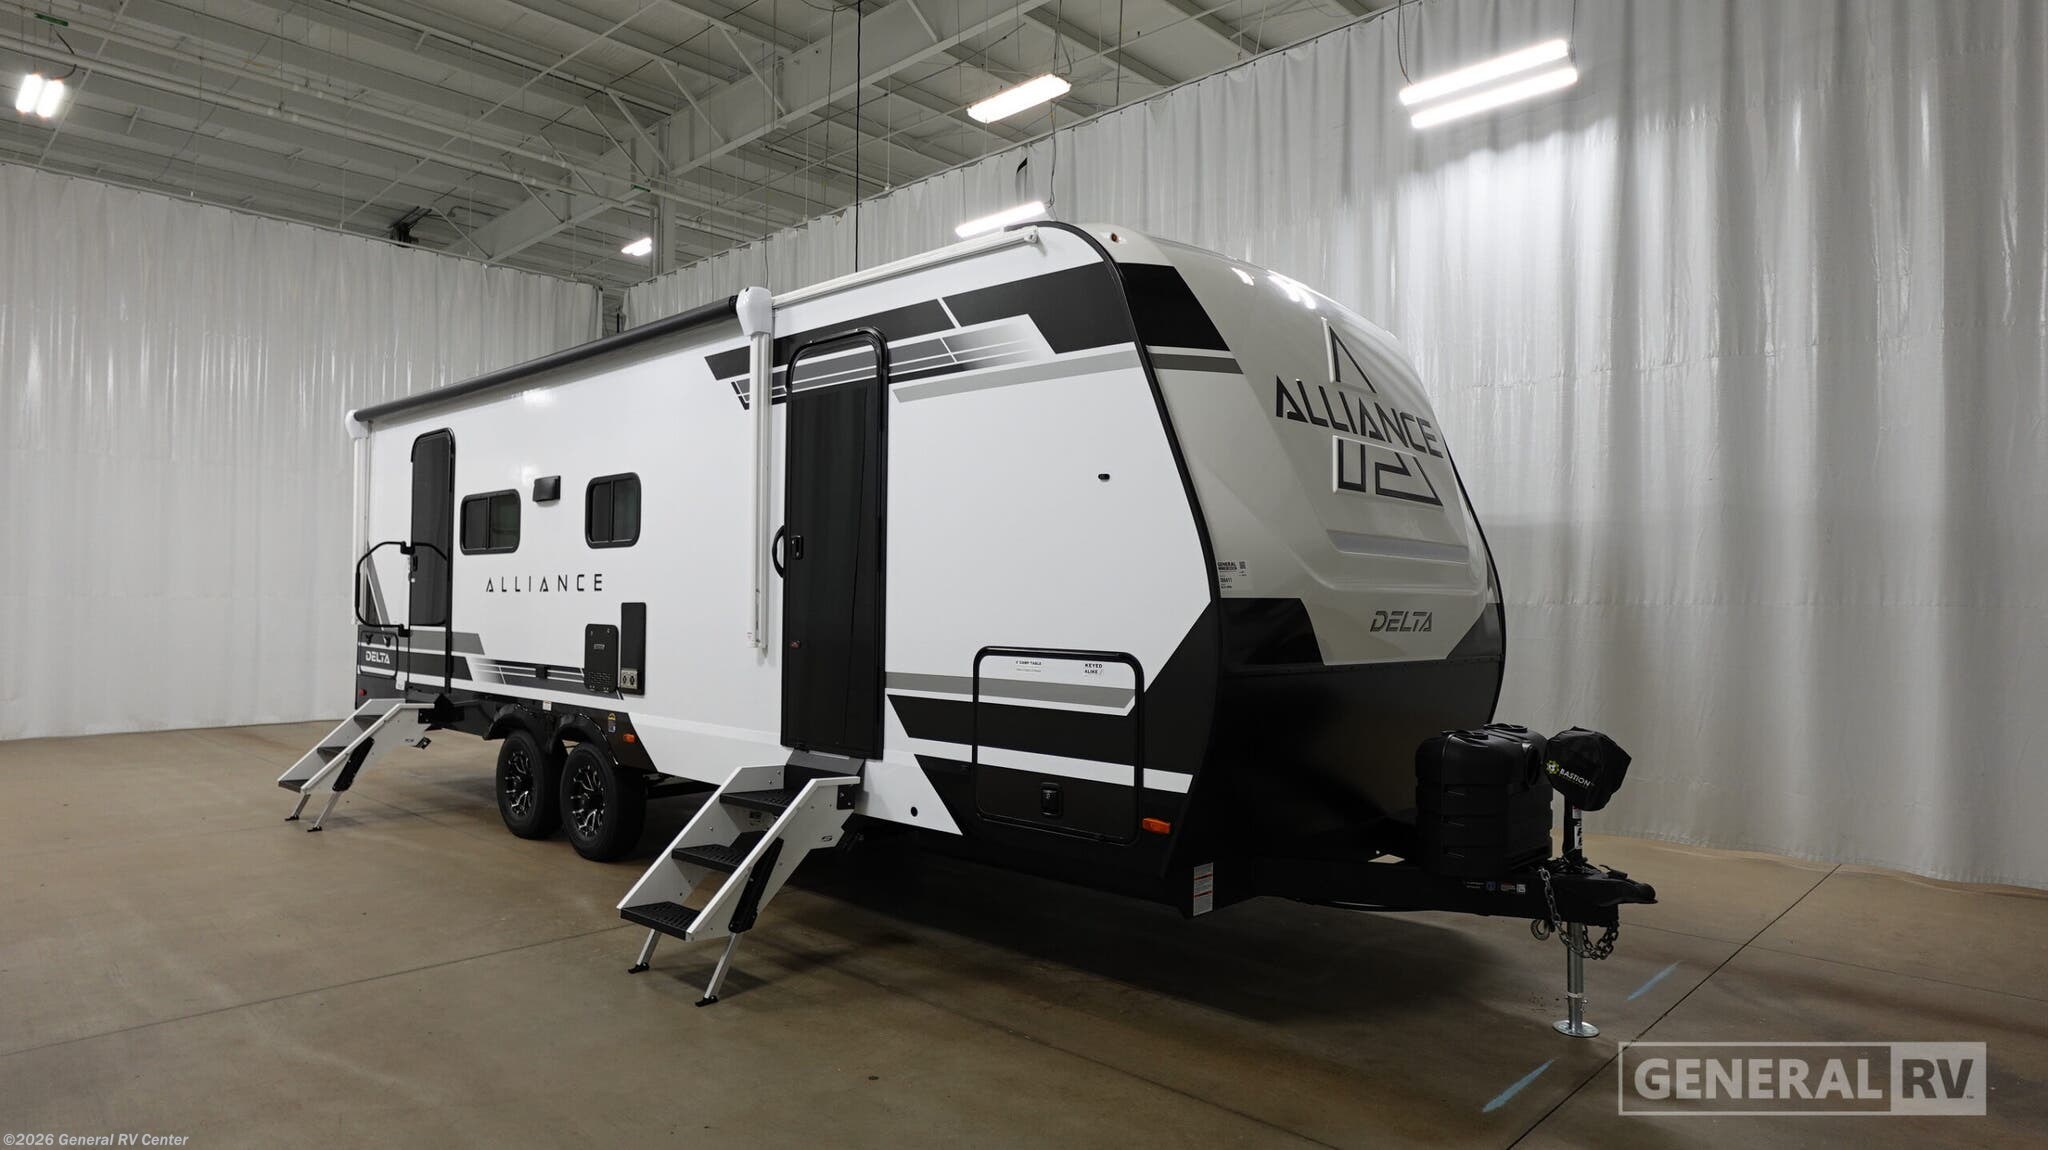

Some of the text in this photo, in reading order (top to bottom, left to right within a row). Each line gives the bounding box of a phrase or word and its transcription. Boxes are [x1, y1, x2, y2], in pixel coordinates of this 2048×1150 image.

[1276, 375, 1443, 458] ALLIANCE
[486, 573, 603, 592] ALLIANCE
[1370, 610, 1433, 632] DELTA
[365, 650, 391, 664] DELTA
[1559, 767, 1591, 788] BASTION
